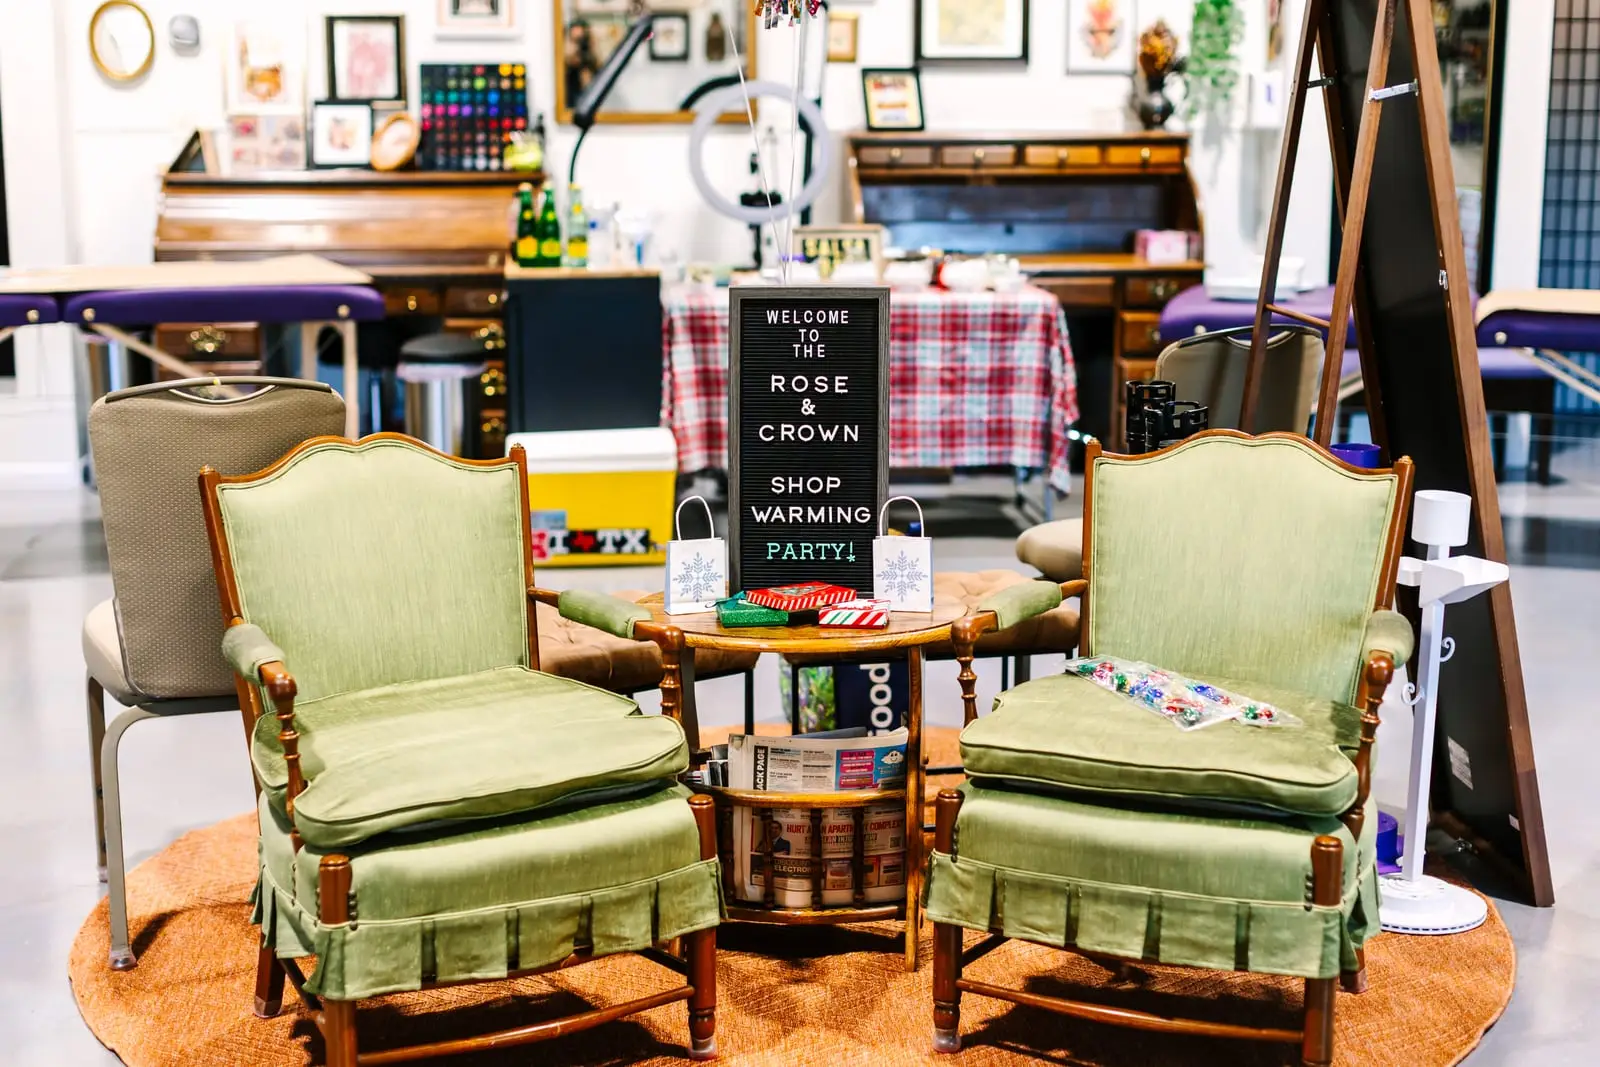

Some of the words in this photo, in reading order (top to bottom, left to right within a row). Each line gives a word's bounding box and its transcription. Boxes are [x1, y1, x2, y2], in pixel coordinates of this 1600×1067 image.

[766, 310, 849, 324] WELCOME
[798, 329, 820, 342] TO
[793, 344, 826, 358] THE
[771, 375, 849, 393] ROSE
[801, 398, 816, 415] &
[759, 424, 859, 442] CROWN
[771, 476, 841, 494] SHOP
[751, 506, 871, 524] WARMING
[596, 529, 647, 554] TX
[766, 542, 856, 562] PARTY!
[757, 749, 766, 771] PAGE
[756, 771, 765, 790] ACK
[786, 823, 806, 834] HURT
